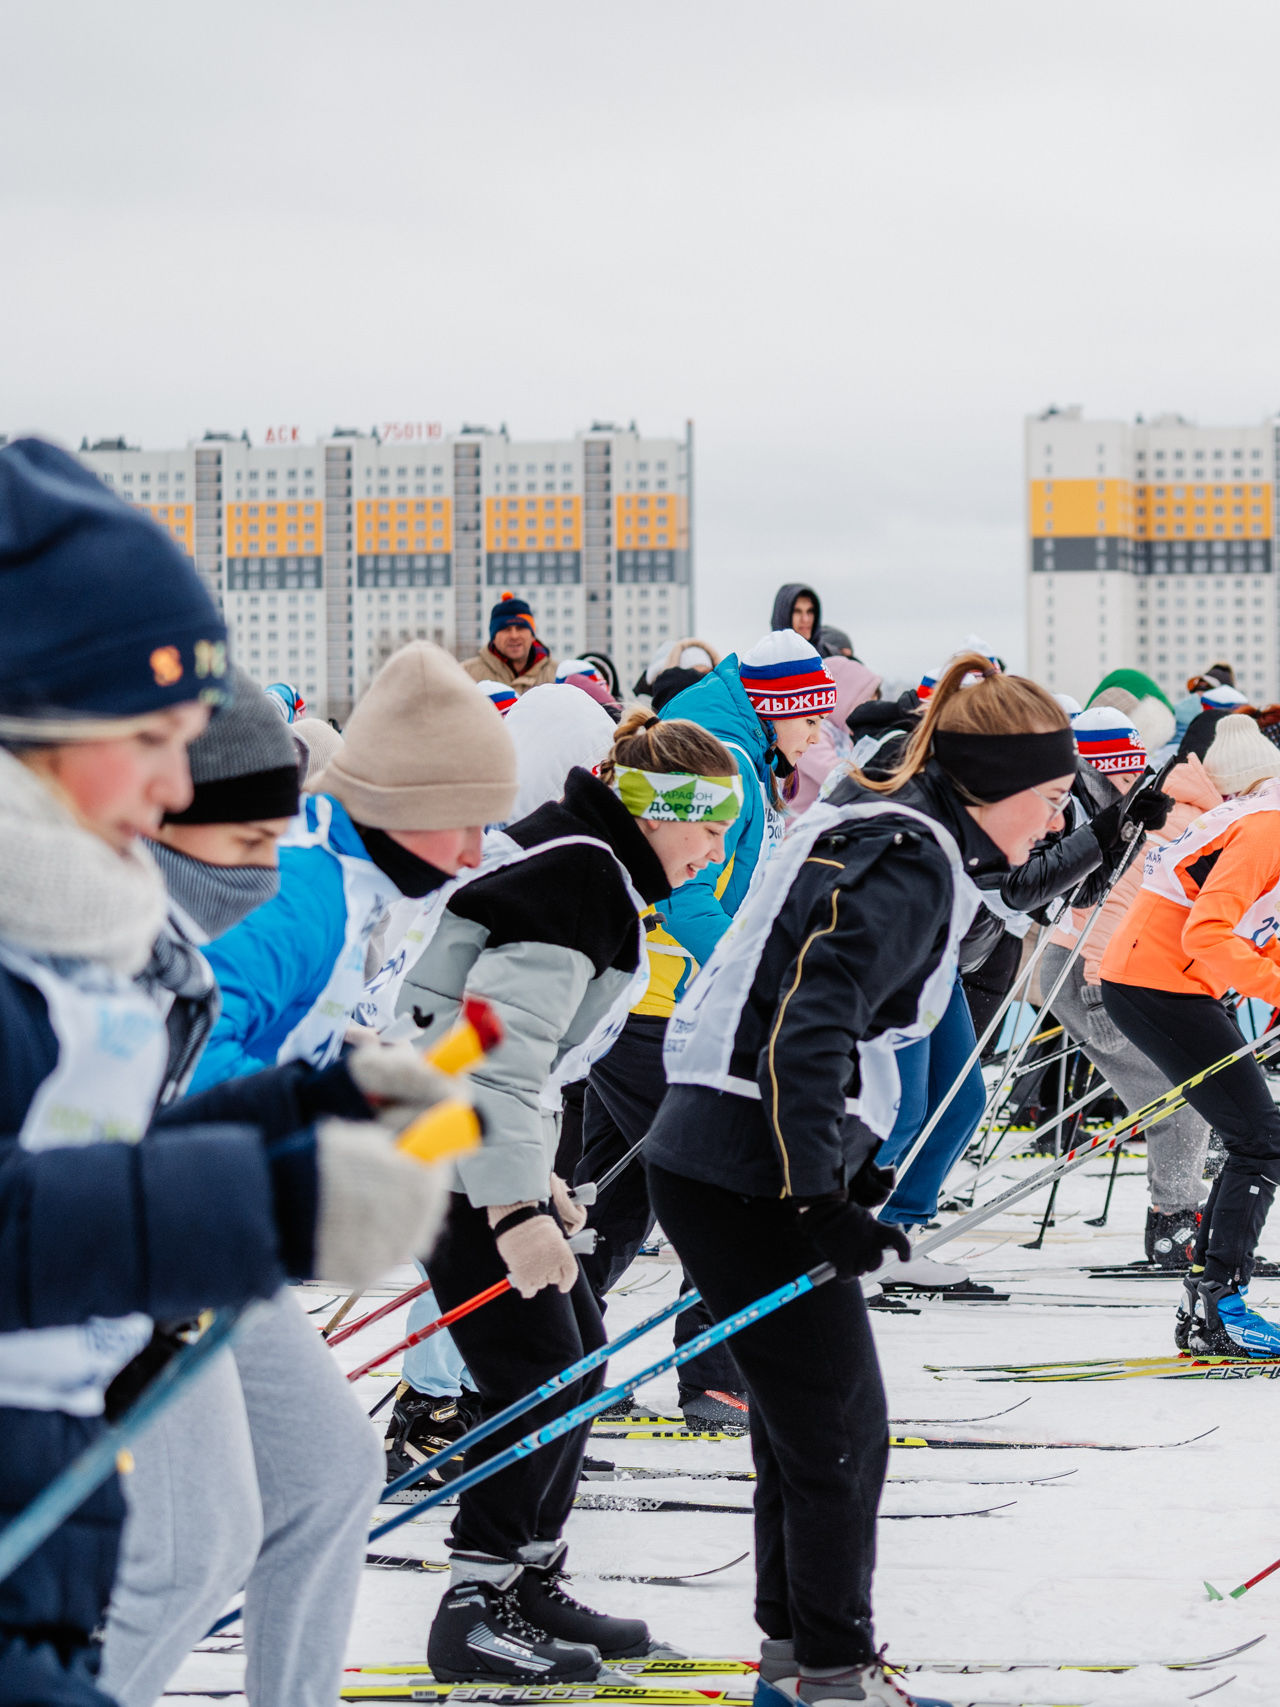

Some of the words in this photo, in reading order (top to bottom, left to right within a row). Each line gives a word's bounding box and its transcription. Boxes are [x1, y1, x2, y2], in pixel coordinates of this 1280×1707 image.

[755, 691, 836, 711] ЛЫЖНЯ
[654, 789, 713, 801] МАРАФОН
[649, 802, 713, 815] ДОРОГА
